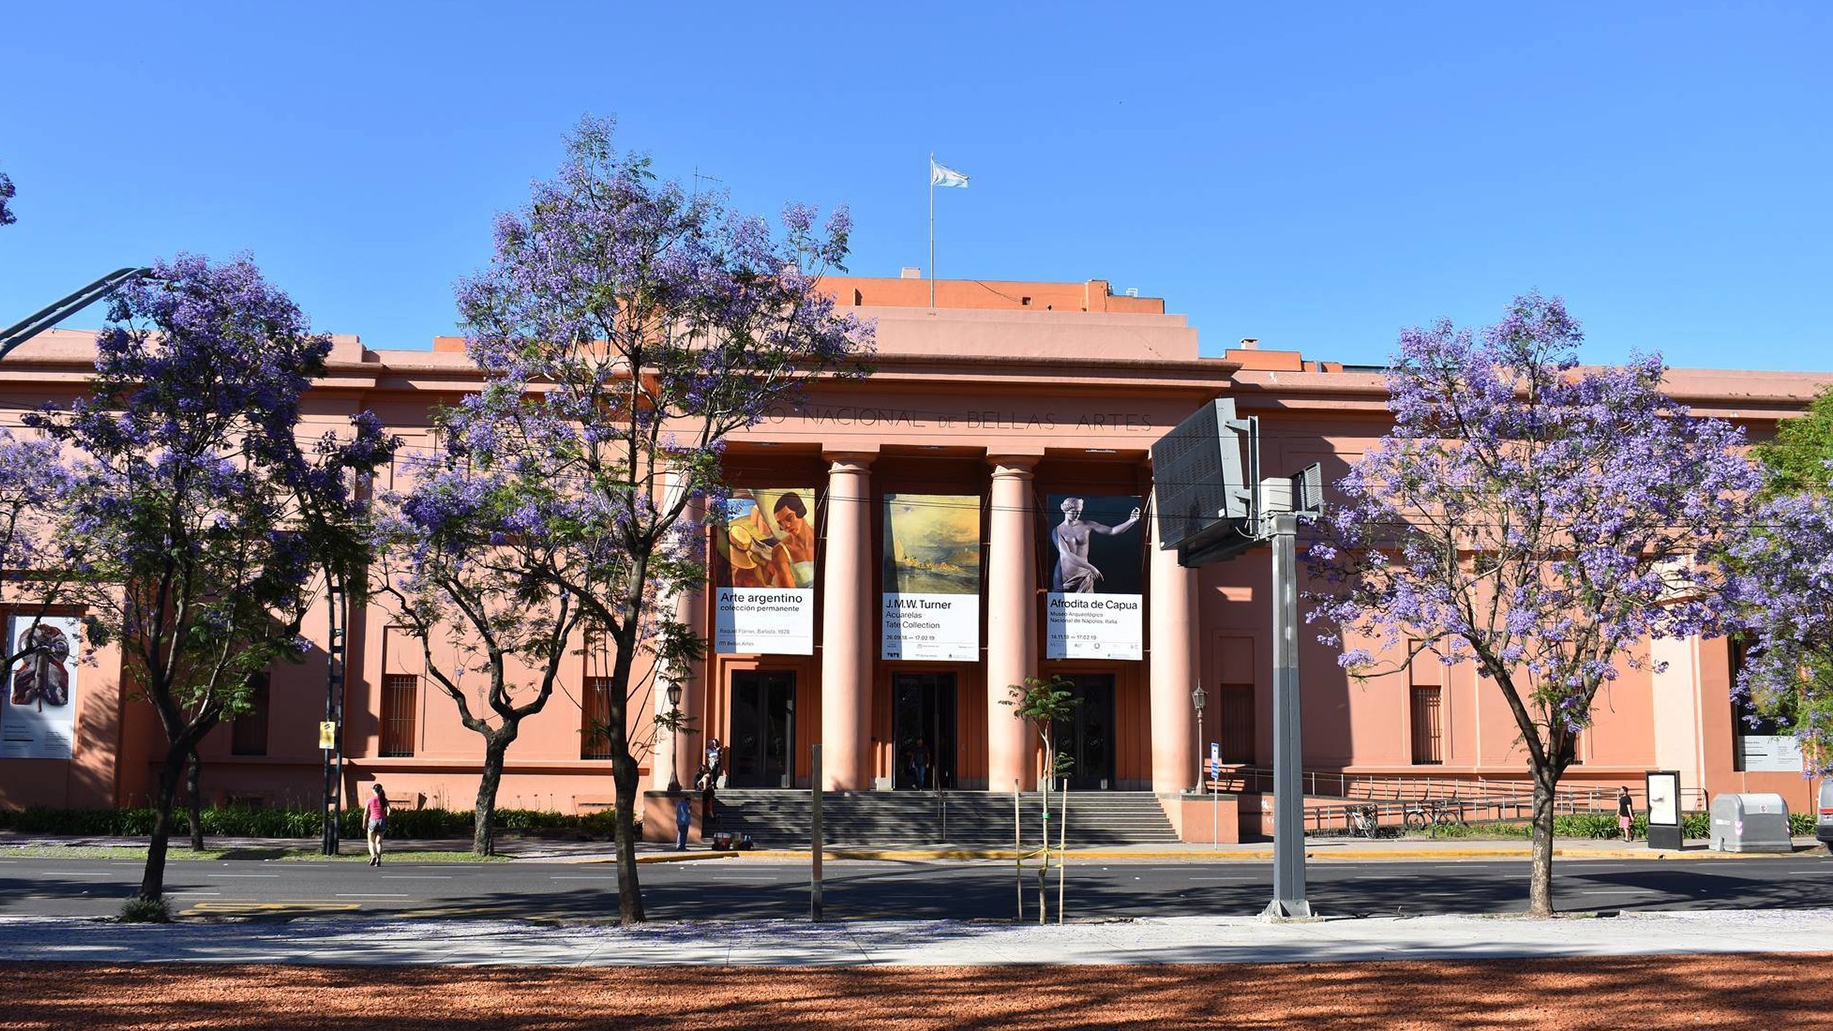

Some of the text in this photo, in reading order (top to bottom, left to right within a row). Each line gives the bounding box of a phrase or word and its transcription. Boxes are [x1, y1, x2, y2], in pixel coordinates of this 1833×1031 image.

[803, 406, 926, 428] NACIONAL
[938, 416, 956, 428] DE
[967, 410, 1056, 431] BELLAS
[1075, 413, 1152, 432] ARTES
[720, 592, 803, 605] Arte argentino
[886, 599, 952, 610] J.M.W. Turner
[1050, 599, 1138, 611] Afrodita de Capua
[886, 611, 922, 619] Acuarelas
[886, 620, 940, 629] Tate Collection
